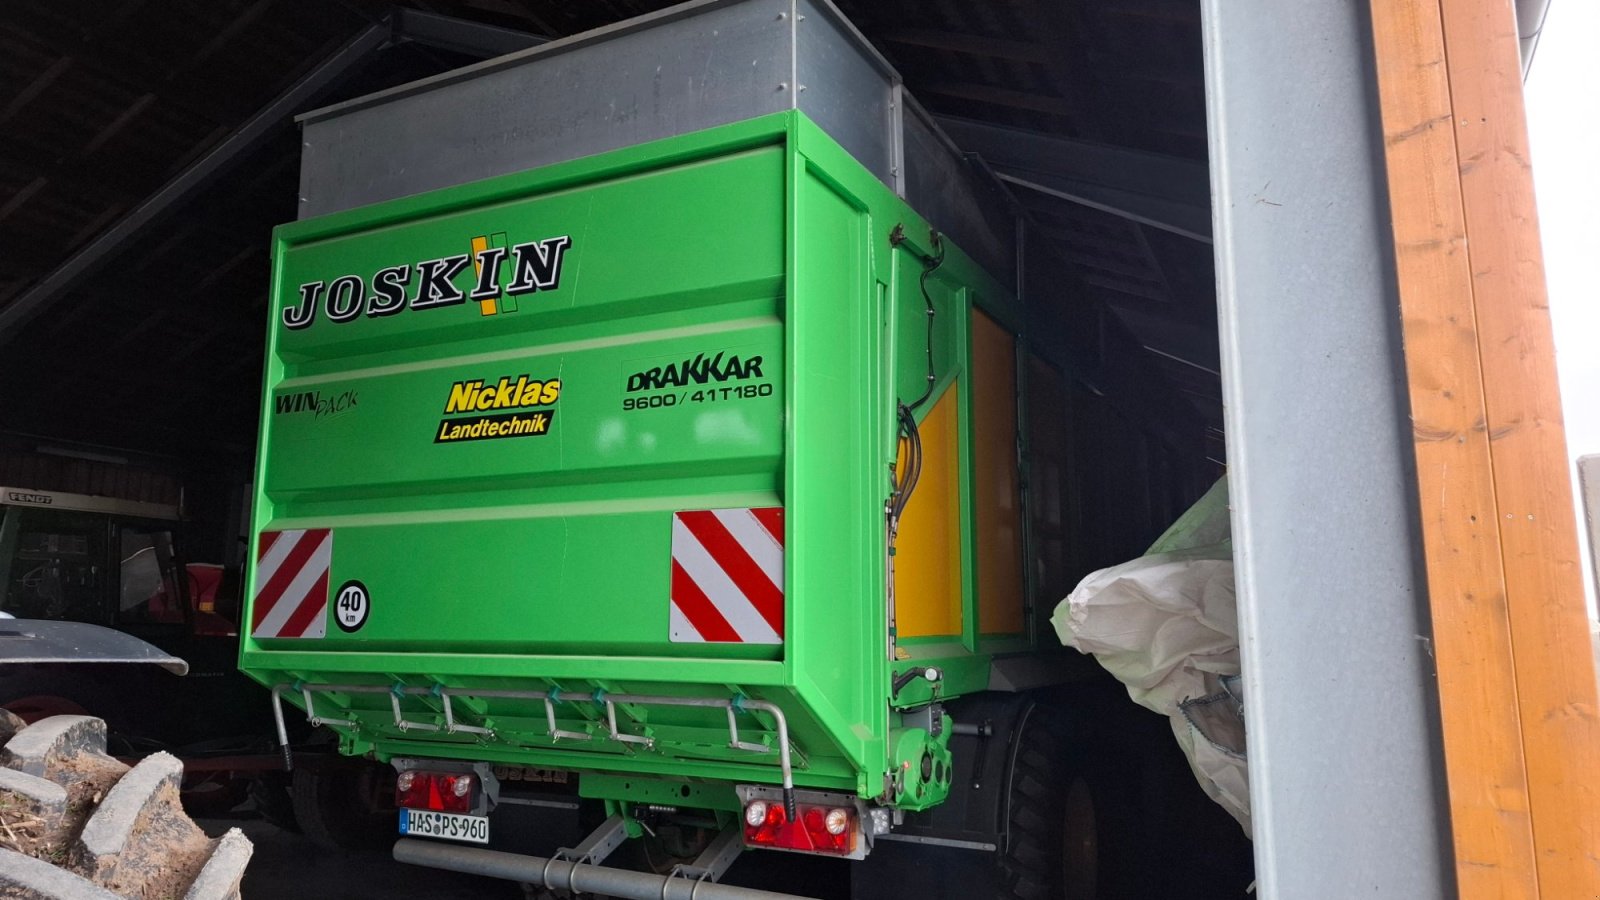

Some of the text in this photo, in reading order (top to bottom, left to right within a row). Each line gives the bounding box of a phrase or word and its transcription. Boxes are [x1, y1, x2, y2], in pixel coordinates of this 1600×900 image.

[282, 235, 571, 329] JOSKIN
[626, 351, 763, 392] DRAKKAR
[444, 374, 561, 414] Nicklas
[439, 413, 547, 441] Landtechnik
[9, 492, 53, 504] FENDT
[340, 591, 361, 611] 40
[345, 613, 356, 622] km
[408, 812, 432, 833] HAS
